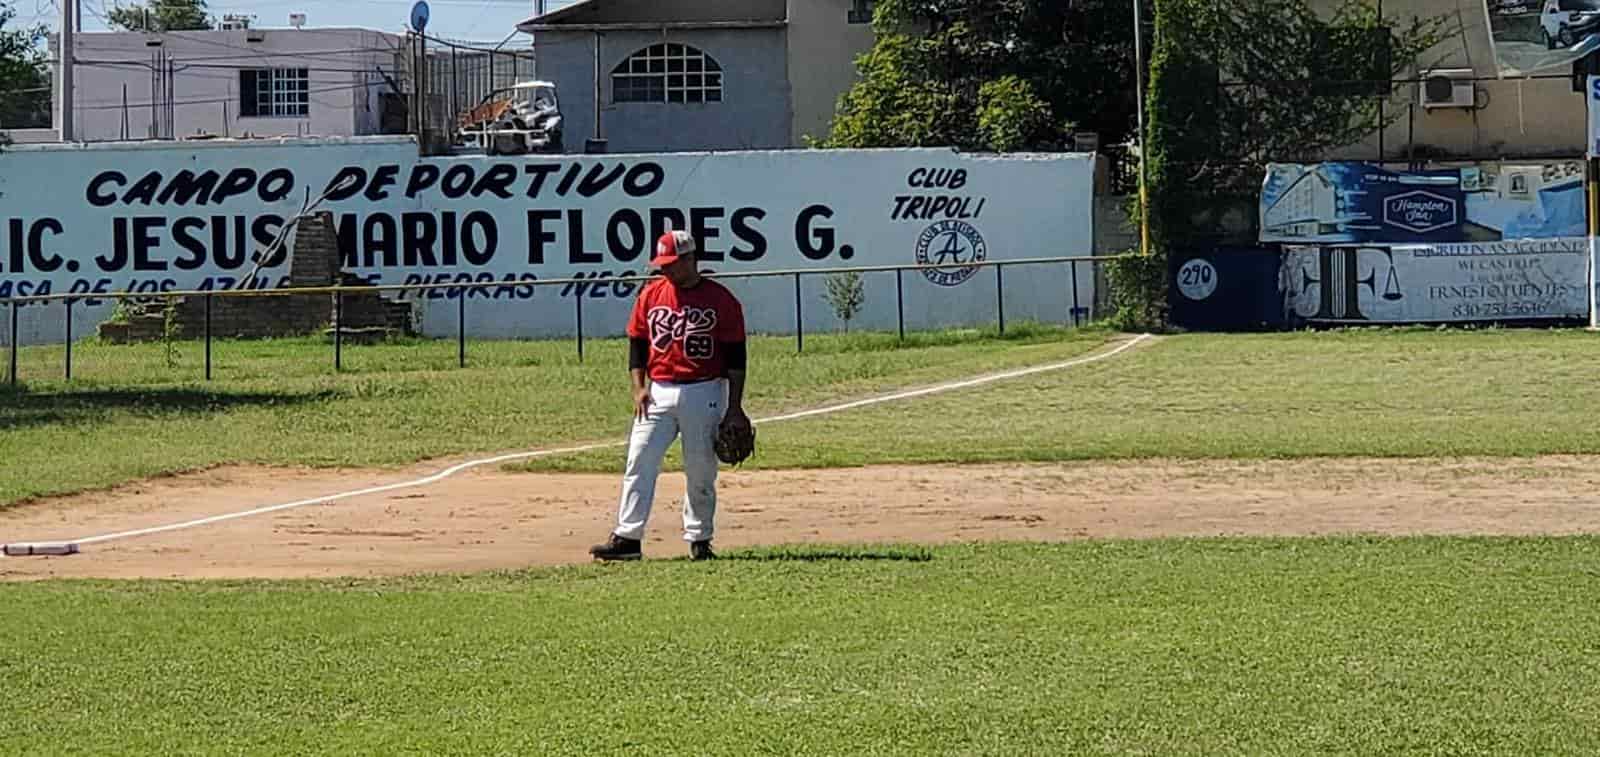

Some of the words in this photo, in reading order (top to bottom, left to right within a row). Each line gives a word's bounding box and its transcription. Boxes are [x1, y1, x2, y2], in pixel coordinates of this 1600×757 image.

[86, 168, 295, 206] CAMPO
[322, 161, 664, 201] DEPORTIVO
[908, 168, 967, 190] CLUB
[891, 196, 984, 220] TRIPOLI
[1391, 198, 1449, 214] Hampton
[1405, 210, 1433, 222] Inn
[0, 217, 80, 273] IC.
[95, 213, 287, 271] JESUS
[315, 209, 498, 270] MARIO
[795, 204, 855, 260] G.
[1182, 264, 1211, 285] 290
[0, 278, 52, 306] ASA
[399, 271, 537, 299] PIEDRAS
[648, 305, 718, 341] Rojos
[684, 335, 713, 359] 69
